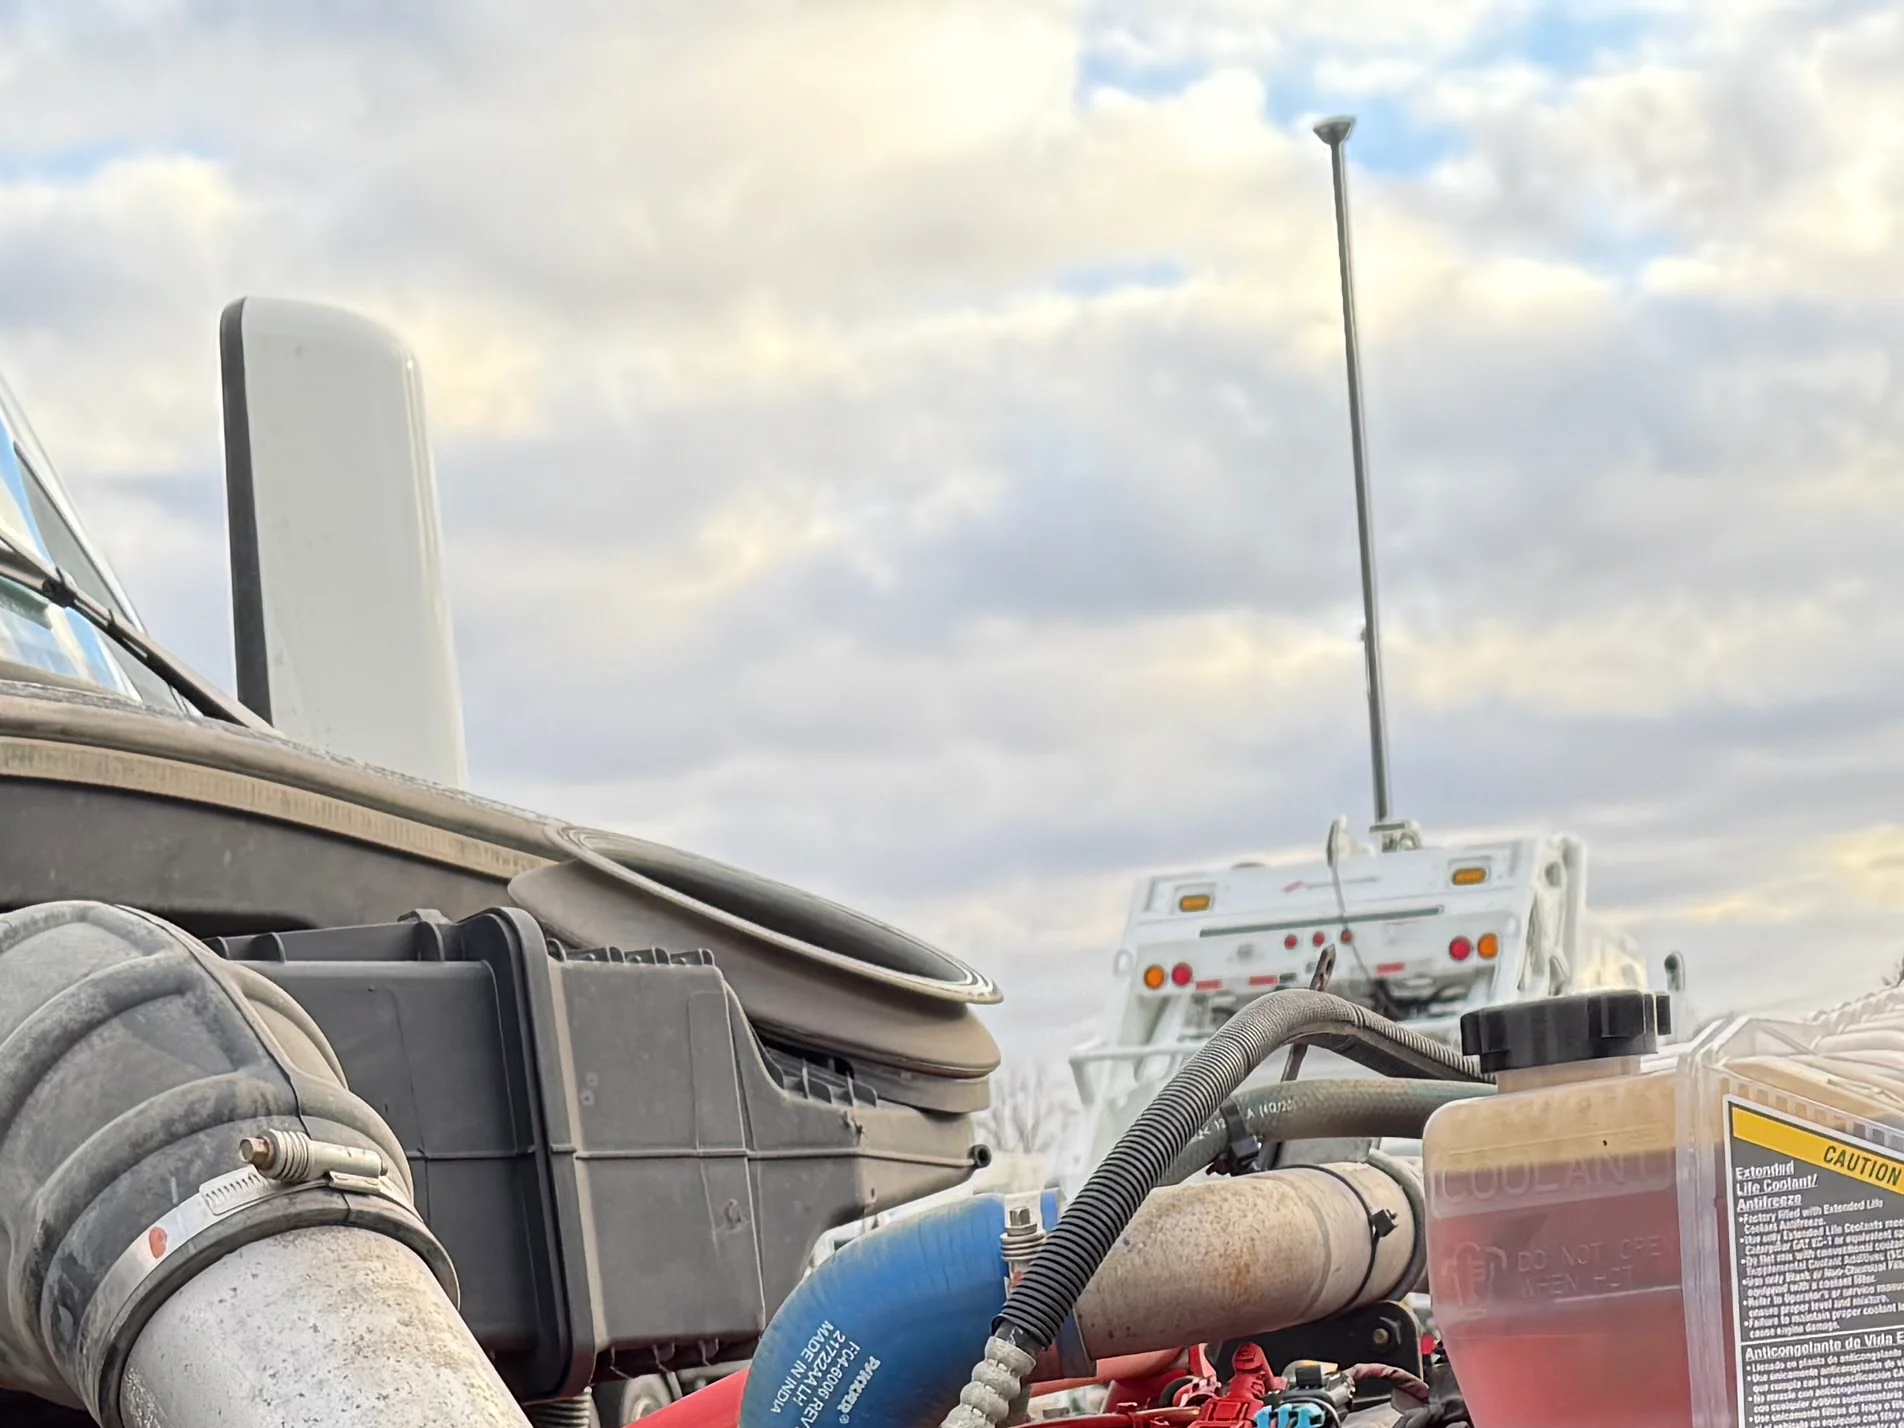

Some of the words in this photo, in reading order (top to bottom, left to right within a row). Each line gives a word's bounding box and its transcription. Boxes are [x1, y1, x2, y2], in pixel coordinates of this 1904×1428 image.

[1444, 1151, 1659, 1201] COOLANT
[1736, 1161, 1794, 1180] Extended
[1823, 1146, 1902, 1187] CAUTION
[1737, 1180, 1762, 1195] Life
[1765, 1173, 1818, 1192] Coolant/
[801, 1320, 834, 1362] MADE
[1746, 1340, 1841, 1361] Anticongelante
[1845, 1337, 1862, 1350] de
[1864, 1333, 1893, 1347] Vida
[791, 1360, 807, 1378] IN
[770, 1375, 798, 1415] INDIA
[793, 1384, 811, 1406] LH
